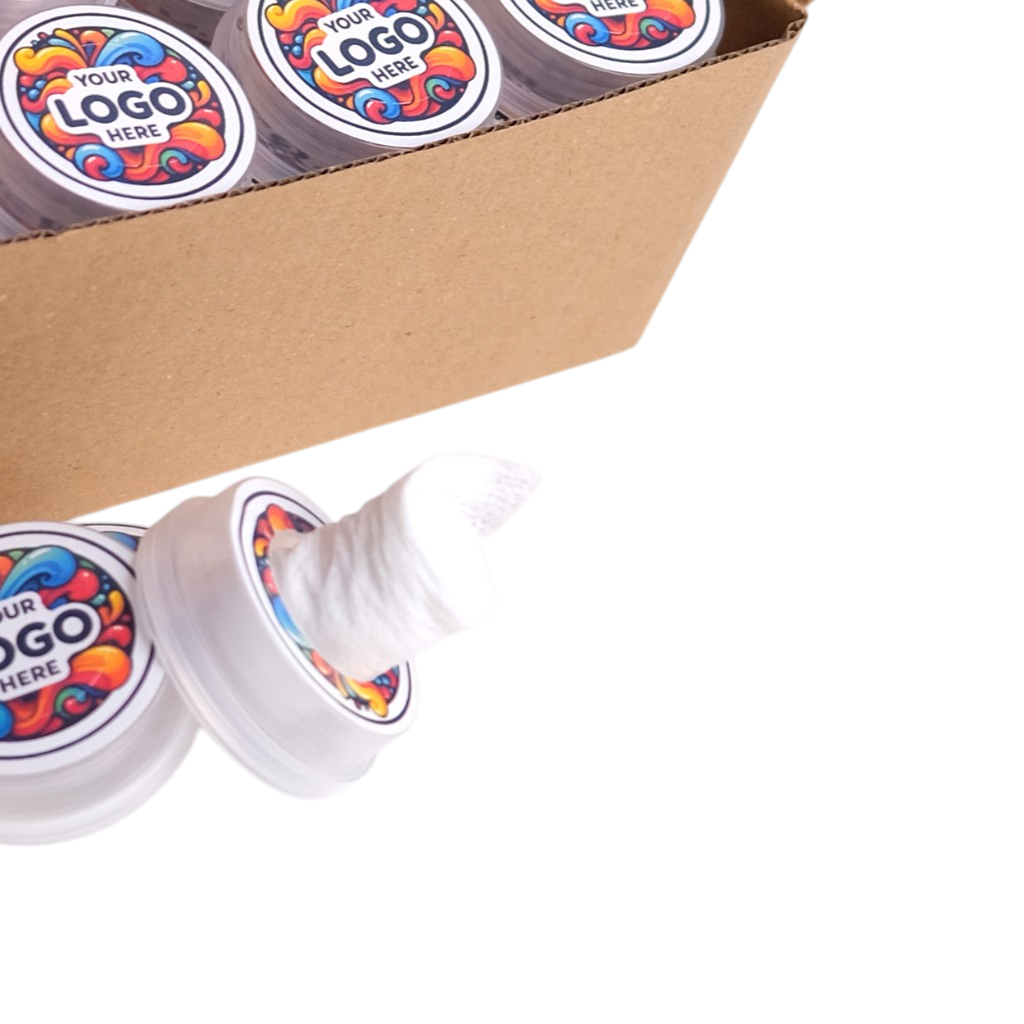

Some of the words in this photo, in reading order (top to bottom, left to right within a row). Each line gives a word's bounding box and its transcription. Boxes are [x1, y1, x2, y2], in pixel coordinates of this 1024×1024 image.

[323, 8, 375, 33] YOUR
[316, 16, 429, 77] LOGO
[73, 69, 133, 87] YOUR
[370, 56, 419, 83] HERE
[53, 86, 187, 128] LOGO
[106, 123, 162, 142] HERE
